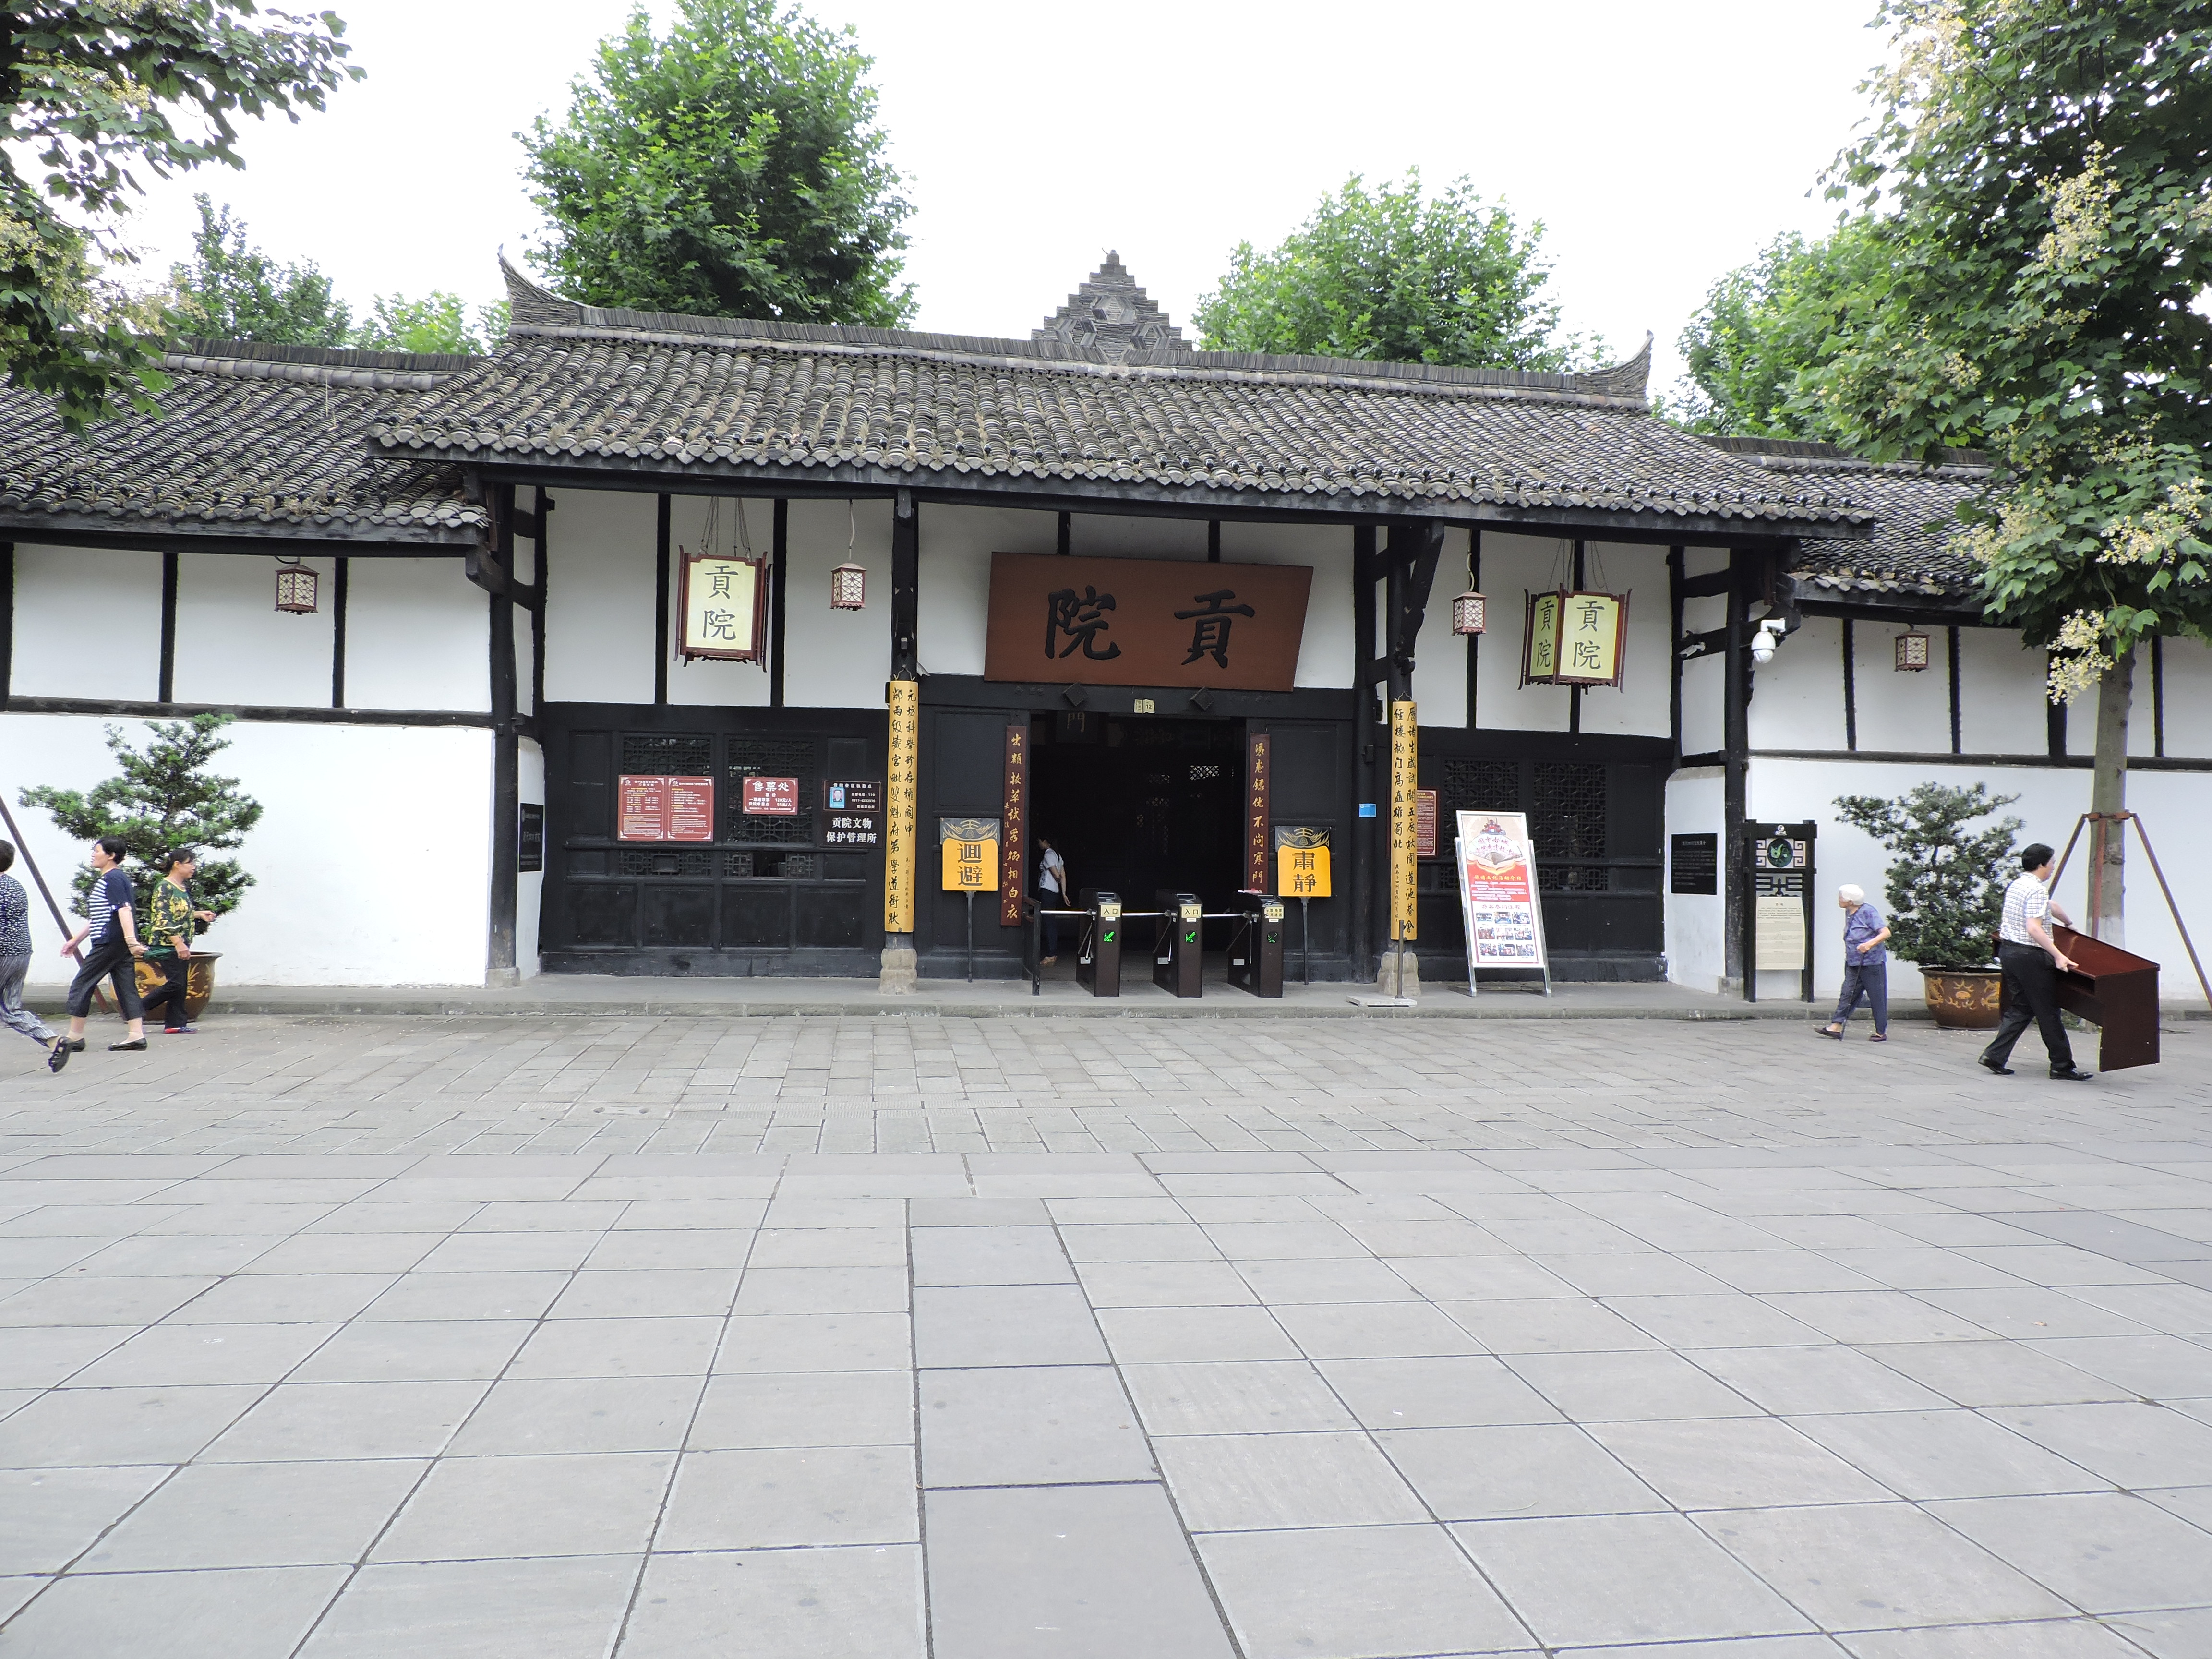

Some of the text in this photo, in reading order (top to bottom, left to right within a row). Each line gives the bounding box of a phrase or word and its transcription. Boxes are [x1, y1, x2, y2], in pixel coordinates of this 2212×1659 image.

[703, 565, 739, 640] 貢院
[1045, 585, 1256, 669] 貢院
[1537, 600, 1555, 668] 貢院
[1573, 600, 1605, 670] 貢院
[752, 781, 790, 792] 售票处
[826, 831, 877, 843] 保护管理所
[832, 817, 872, 829] 贡院文物
[1292, 851, 1317, 893] 肅靜
